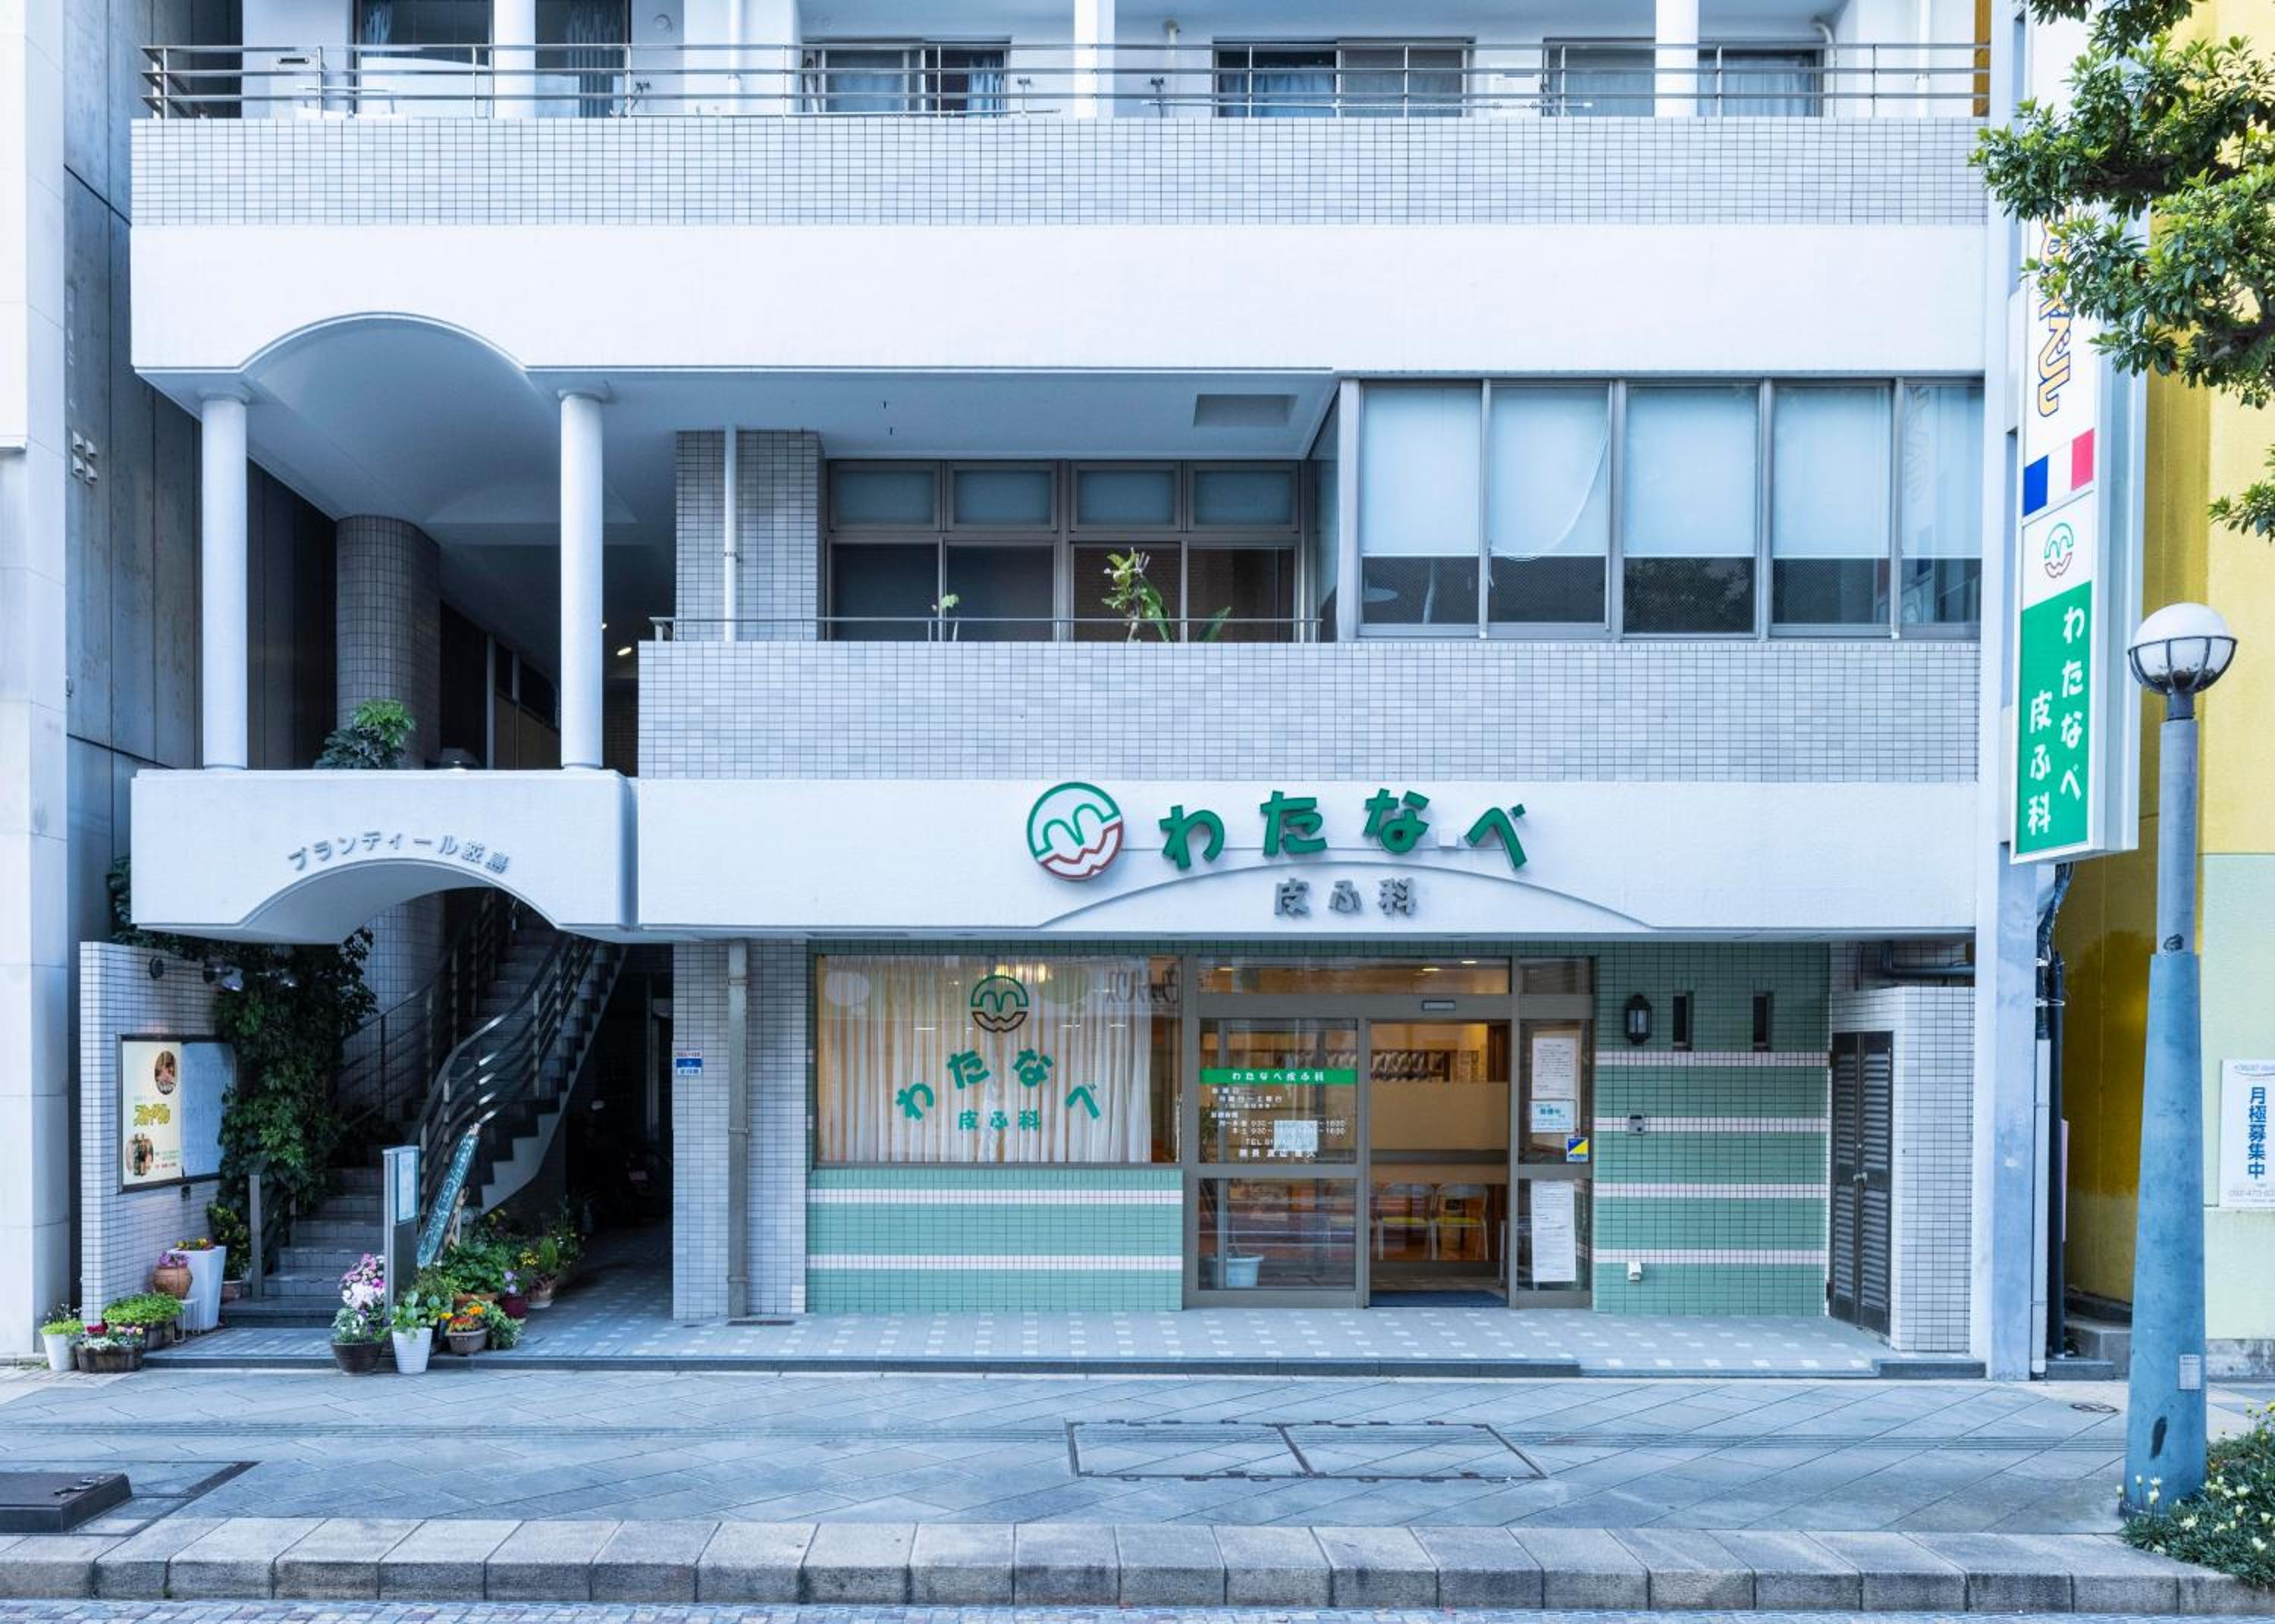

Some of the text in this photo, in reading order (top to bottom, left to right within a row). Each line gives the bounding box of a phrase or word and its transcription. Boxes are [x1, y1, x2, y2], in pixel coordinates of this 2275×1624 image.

[2060, 605, 2085, 801] わたなべ
[2027, 689, 2054, 836] 皮ふ科
[1159, 788, 1527, 871] わたなべ
[1274, 876, 1417, 917] 皮ふ科
[895, 1048, 1101, 1121] わたなべ
[1232, 1071, 1324, 1082] わたなべ皮ふ科
[958, 1109, 1042, 1132] 皮ふ科
[2247, 1086, 2267, 1180] 月極募集中
